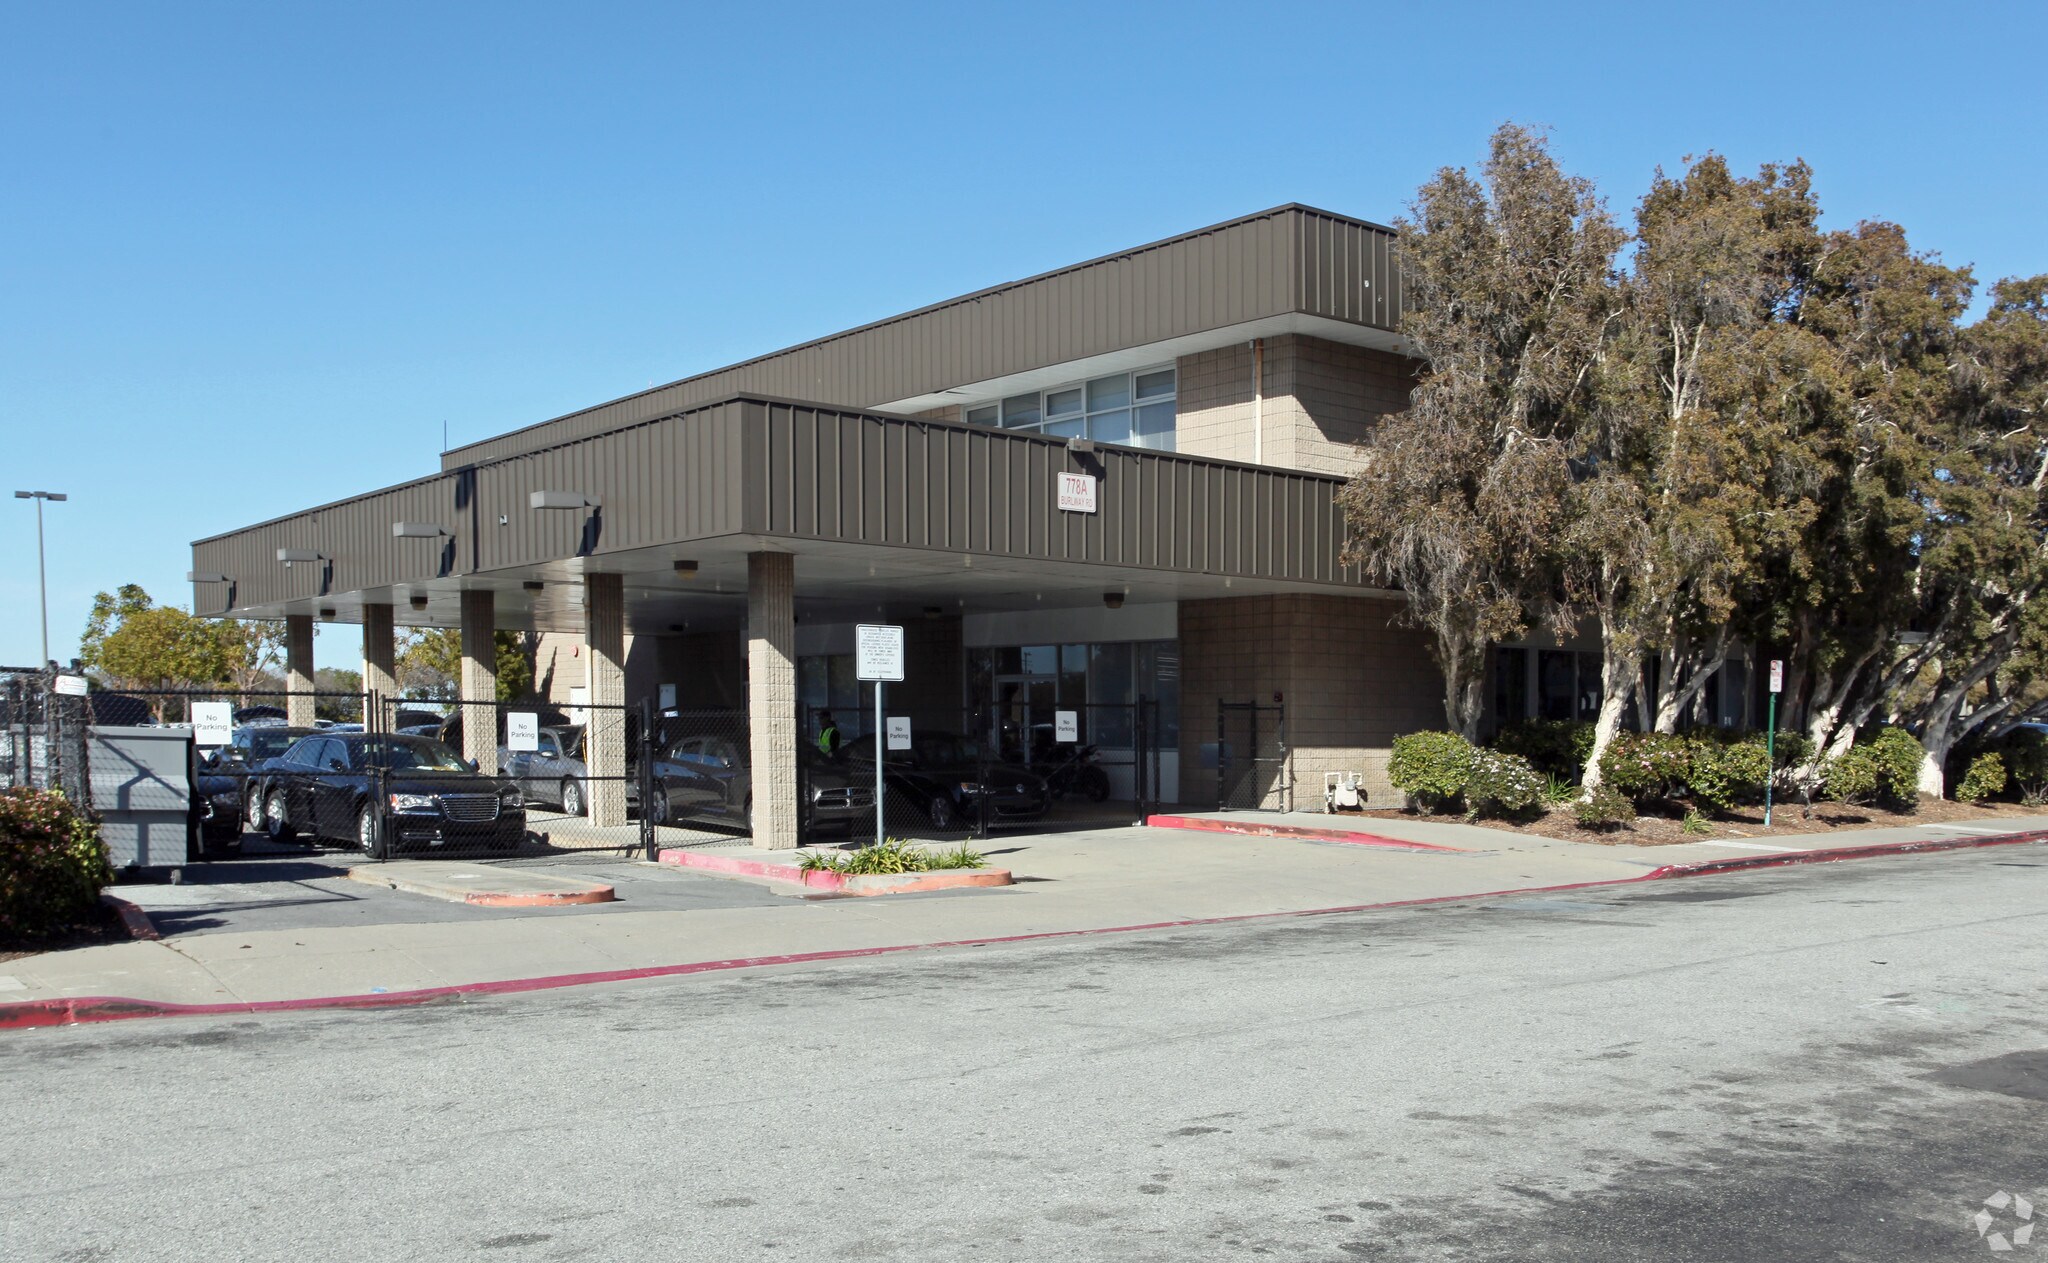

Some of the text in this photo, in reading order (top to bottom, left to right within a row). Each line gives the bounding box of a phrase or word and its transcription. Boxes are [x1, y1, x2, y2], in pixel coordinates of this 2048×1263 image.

[1066, 478, 1087, 495] 778A
[196, 723, 228, 732] Parking
[511, 731, 535, 740] Parking
